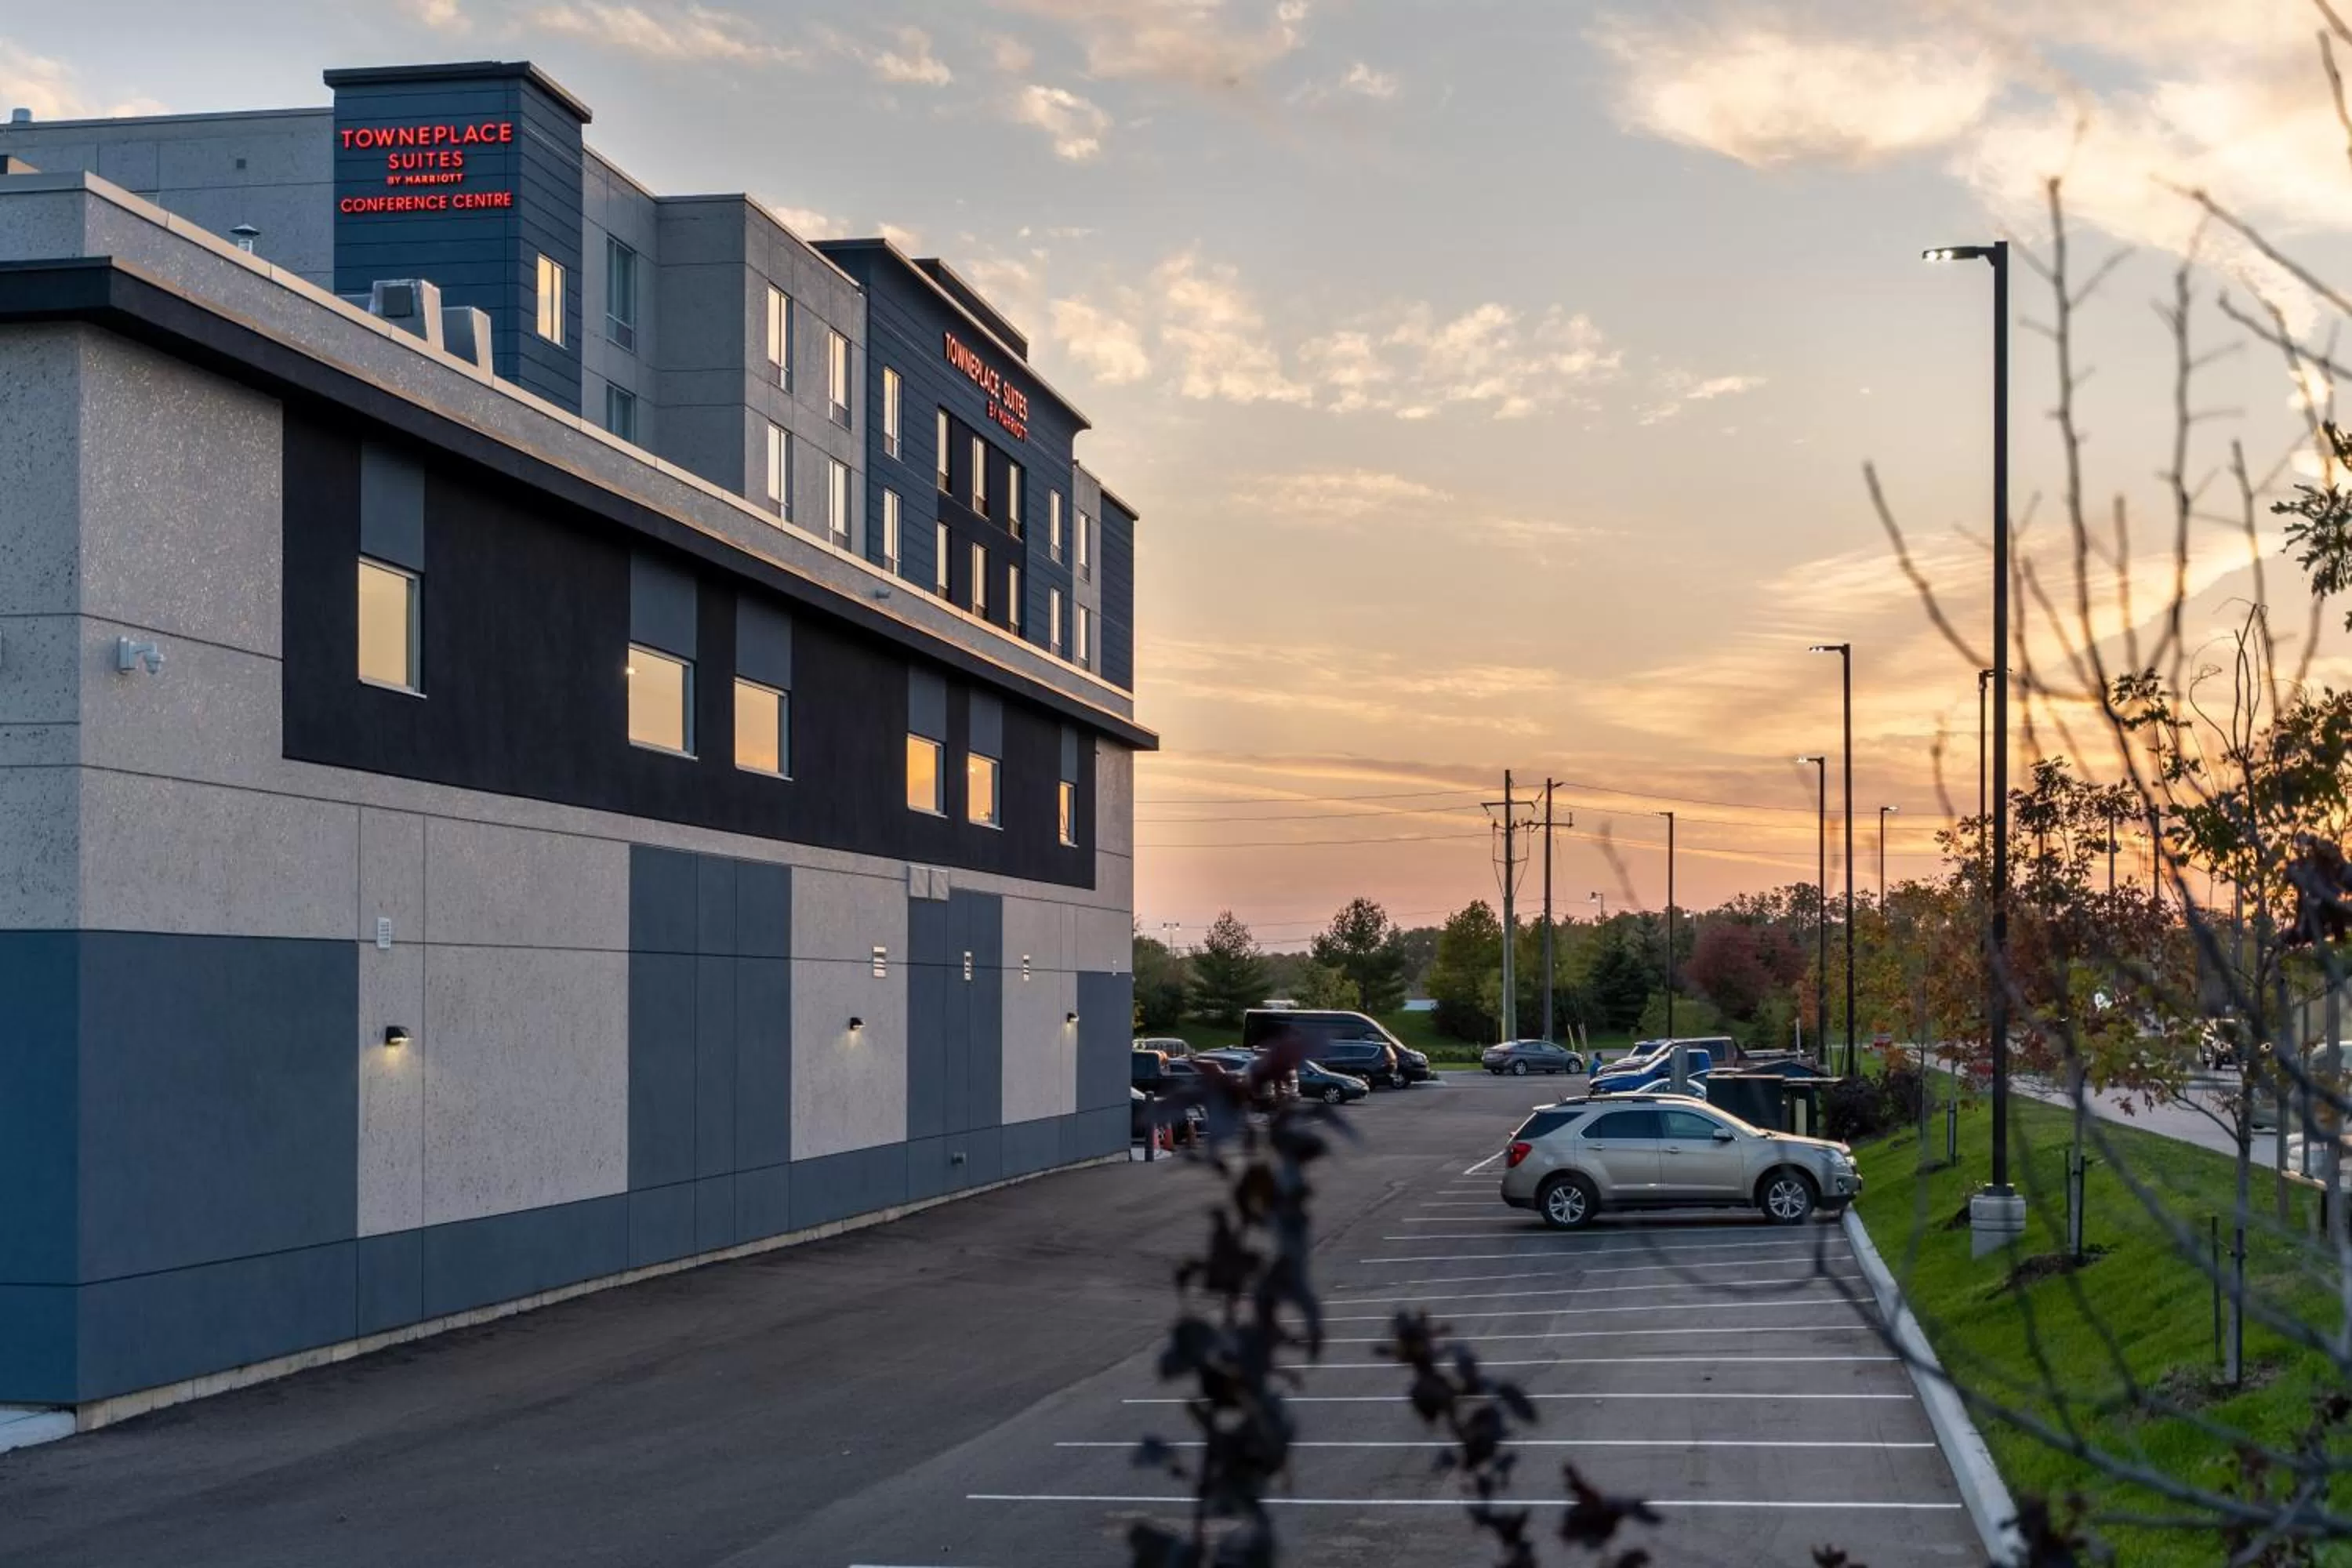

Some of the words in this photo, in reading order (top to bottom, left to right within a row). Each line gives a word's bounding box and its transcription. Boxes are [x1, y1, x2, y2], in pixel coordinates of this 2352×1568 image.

[341, 123, 513, 148] TOWNEPLACE
[388, 151, 463, 169] SUITES
[387, 174, 401, 185] BY
[405, 172, 463, 184] MARRIOTT
[340, 196, 447, 212] CONFERENCE
[452, 192, 512, 209] CENTRE
[945, 332, 999, 399] TOWNEPLACE
[1003, 379, 1028, 422] SUITES
